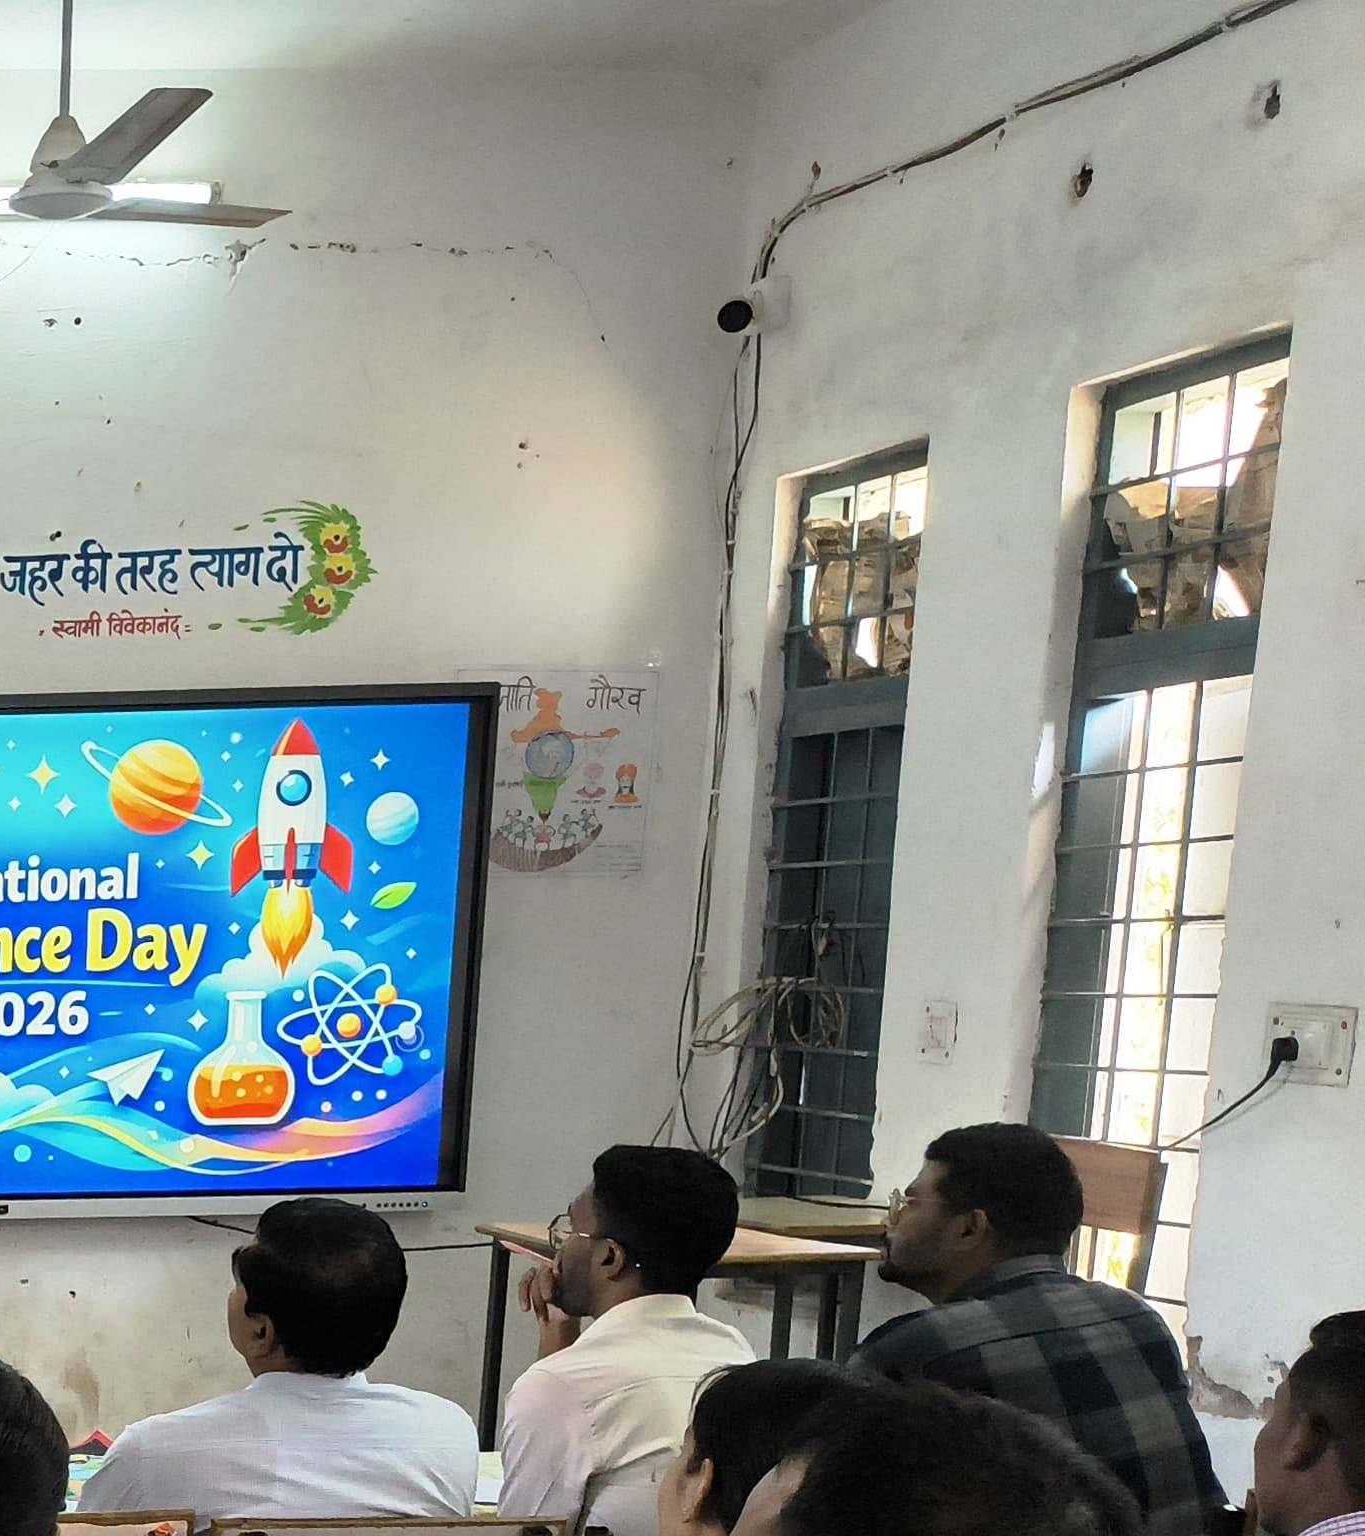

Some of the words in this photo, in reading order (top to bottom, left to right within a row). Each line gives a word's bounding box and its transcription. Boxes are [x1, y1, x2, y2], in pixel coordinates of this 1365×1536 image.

[0, 554, 70, 606] जहर
[70, 539, 112, 594] की
[115, 548, 183, 595] तरह
[188, 546, 265, 592] त्याग
[265, 531, 305, 592] दो
[586, 674, 647, 715] गौरव
[85, 907, 208, 987] Day
